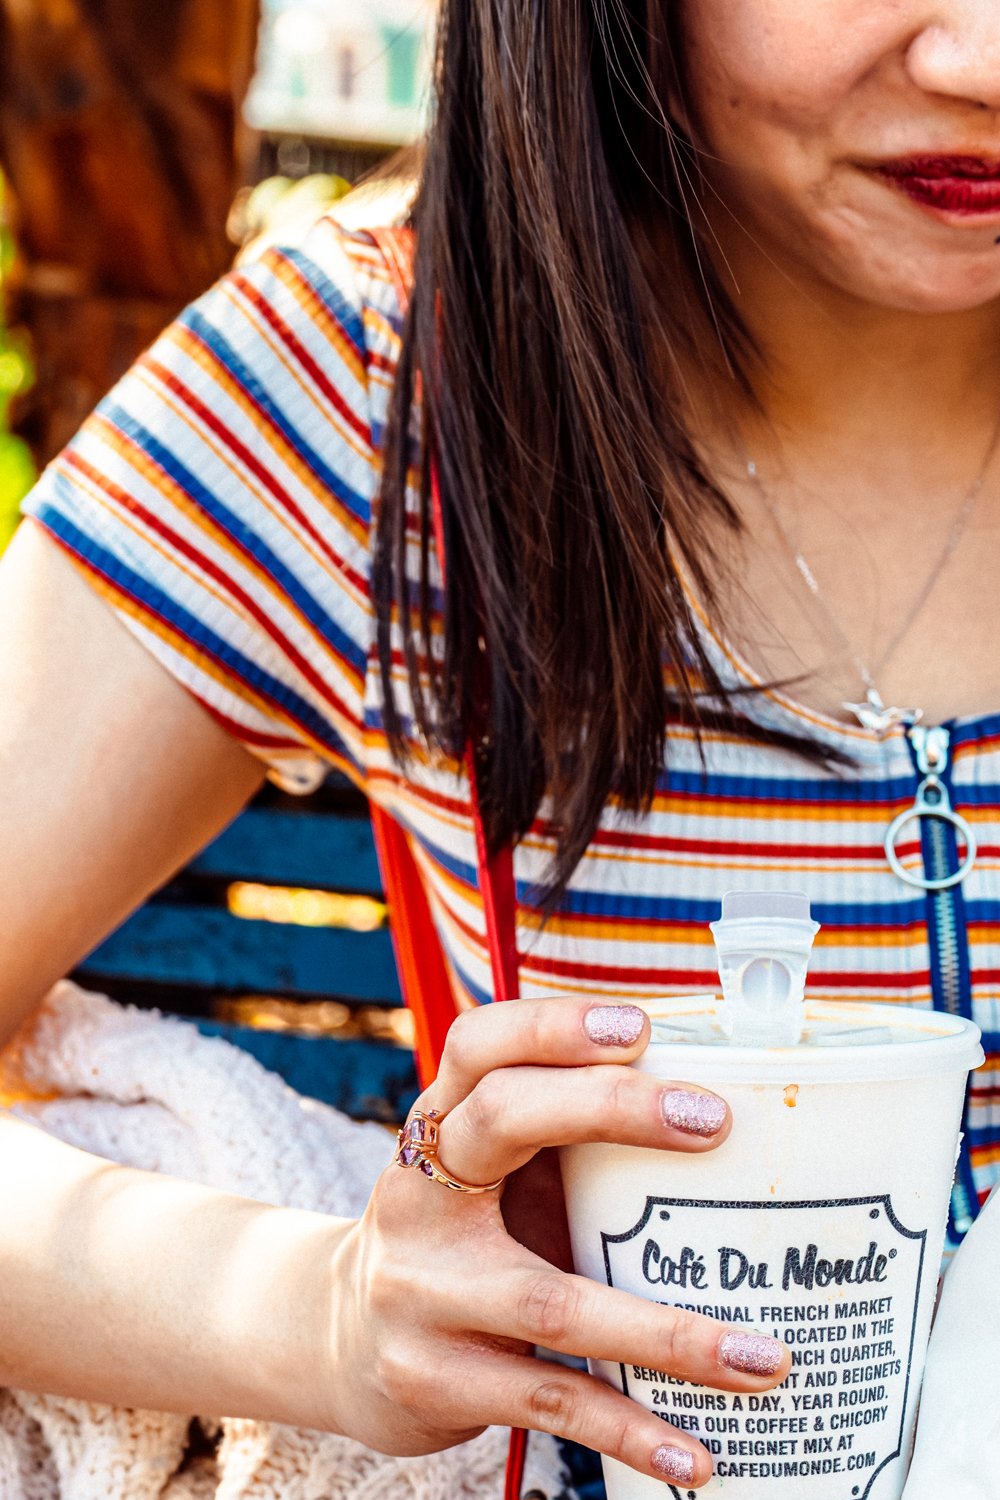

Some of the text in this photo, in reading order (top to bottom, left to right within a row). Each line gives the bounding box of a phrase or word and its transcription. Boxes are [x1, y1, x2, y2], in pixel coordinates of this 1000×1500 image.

[642, 1239, 708, 1289] Café
[718, 1247, 773, 1290] Du
[761, 1305, 828, 1321] FRENCH
[835, 1297, 892, 1318] MARKET
[853, 1323, 866, 1339] IN
[871, 1319, 893, 1336] THE
[792, 1341, 895, 1366] NCH QUARTER,
[805, 1371, 837, 1387] AND
[843, 1360, 900, 1384] BEIGNETS
[652, 1386, 888, 1413] 24 HOURS A DAY, YEAR ROUND.
[705, 1417, 739, 1433] OUR
[746, 1417, 807, 1433] COFFEE
[814, 1416, 823, 1431] &
[831, 1406, 887, 1429] CHICORY
[699, 1434, 854, 1455] ND BEIGNET MIX AT
[712, 1452, 875, 1477] .CAFEDUMONDE.COM
